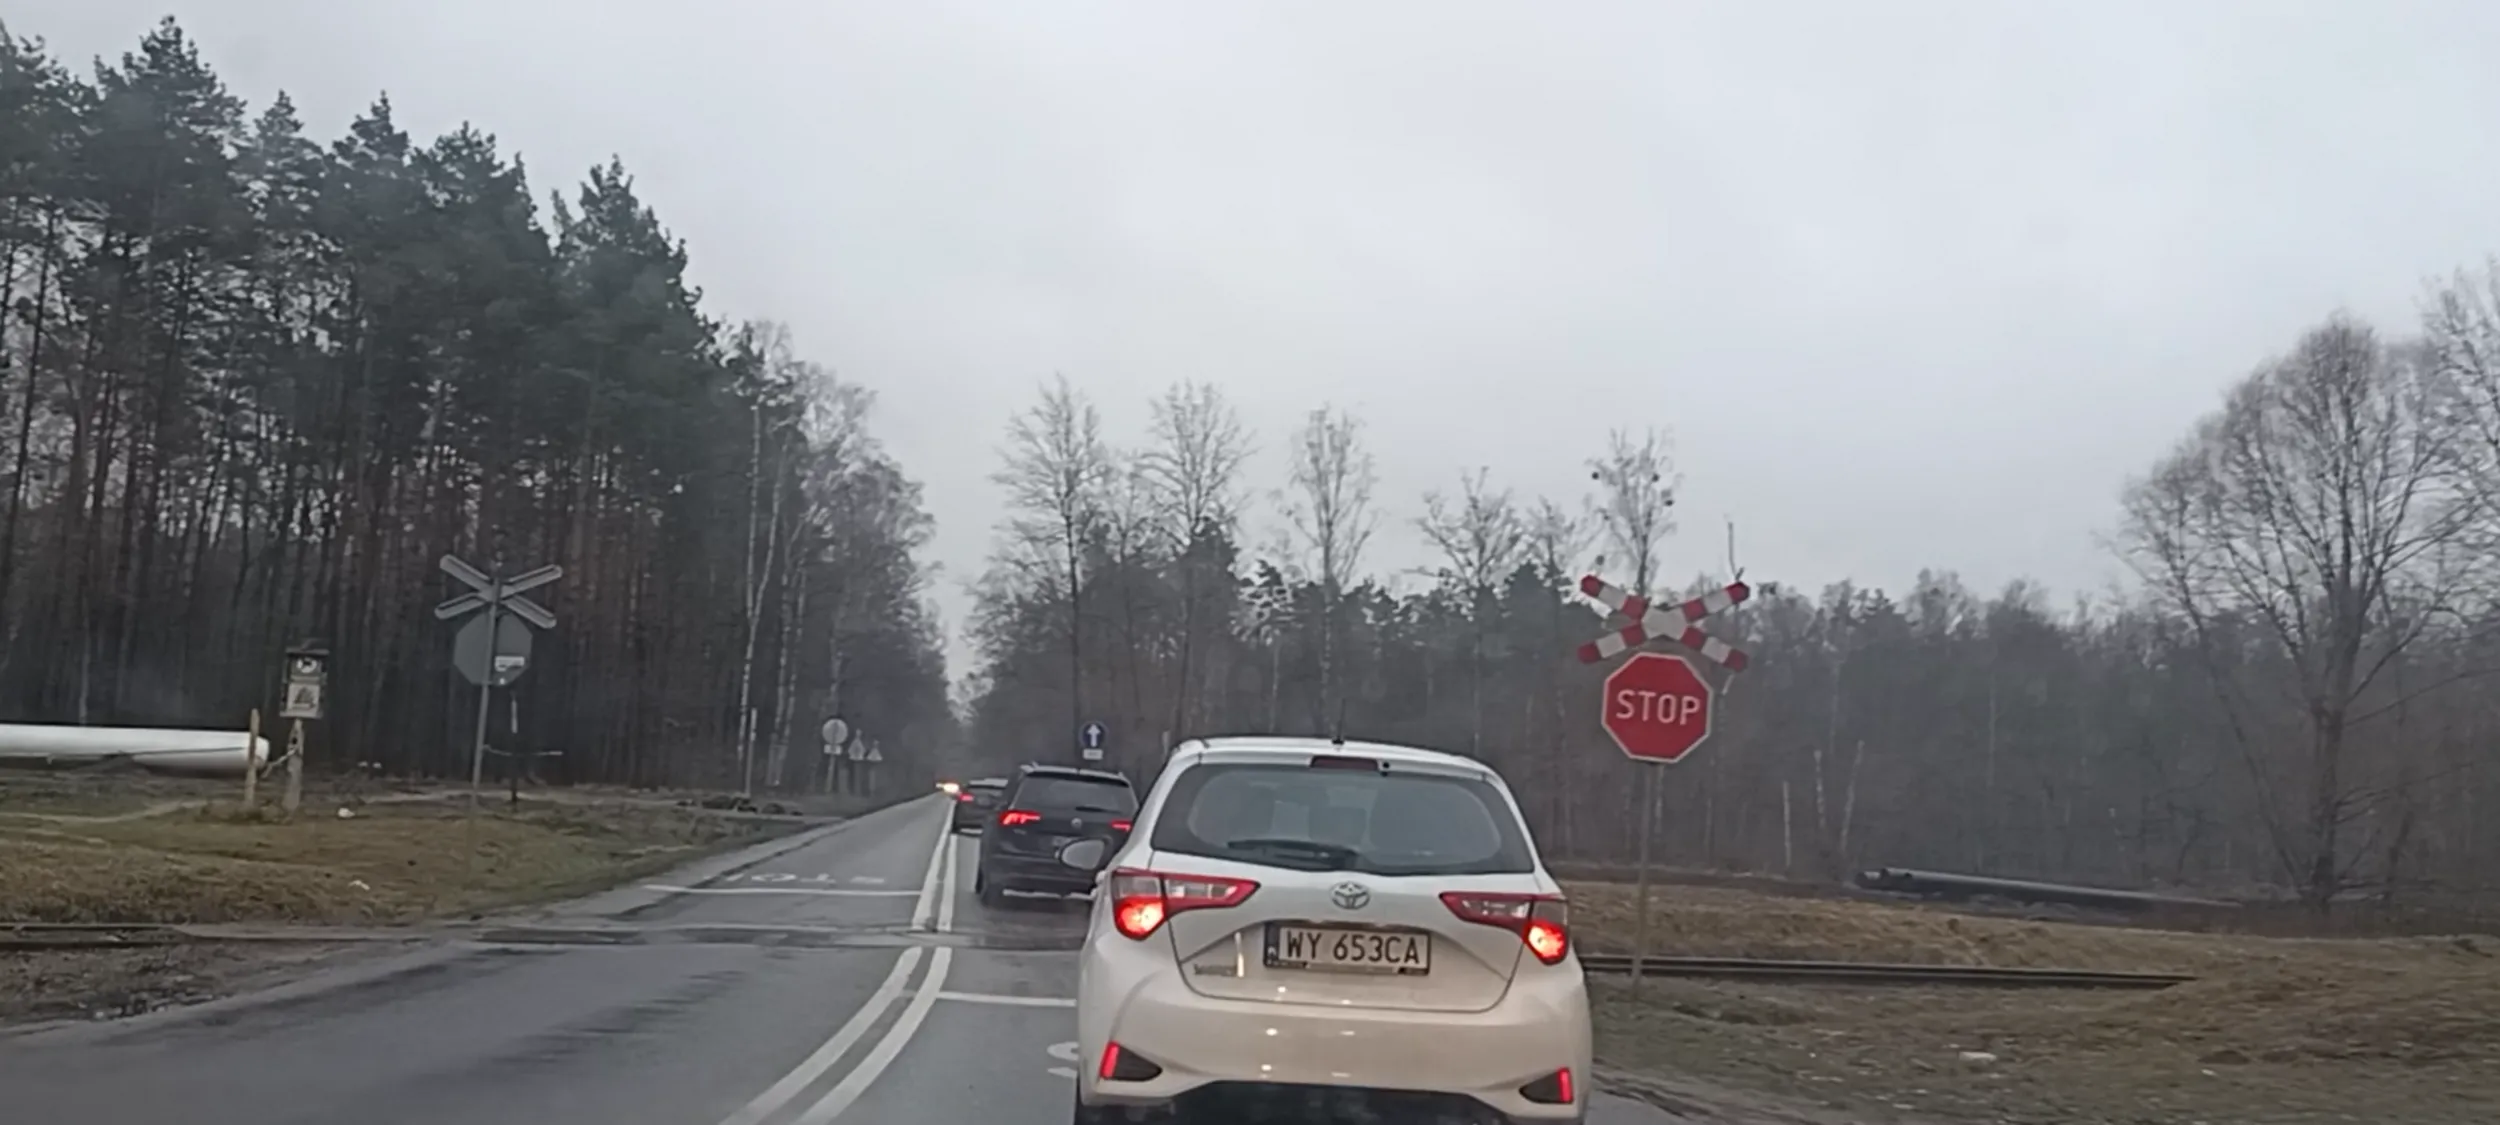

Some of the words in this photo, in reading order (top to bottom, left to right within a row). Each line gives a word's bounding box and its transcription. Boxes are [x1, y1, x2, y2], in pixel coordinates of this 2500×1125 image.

[1615, 689, 1700, 726] STOP
[1287, 931, 1322, 960] WY
[1333, 934, 1420, 965] 653CA
